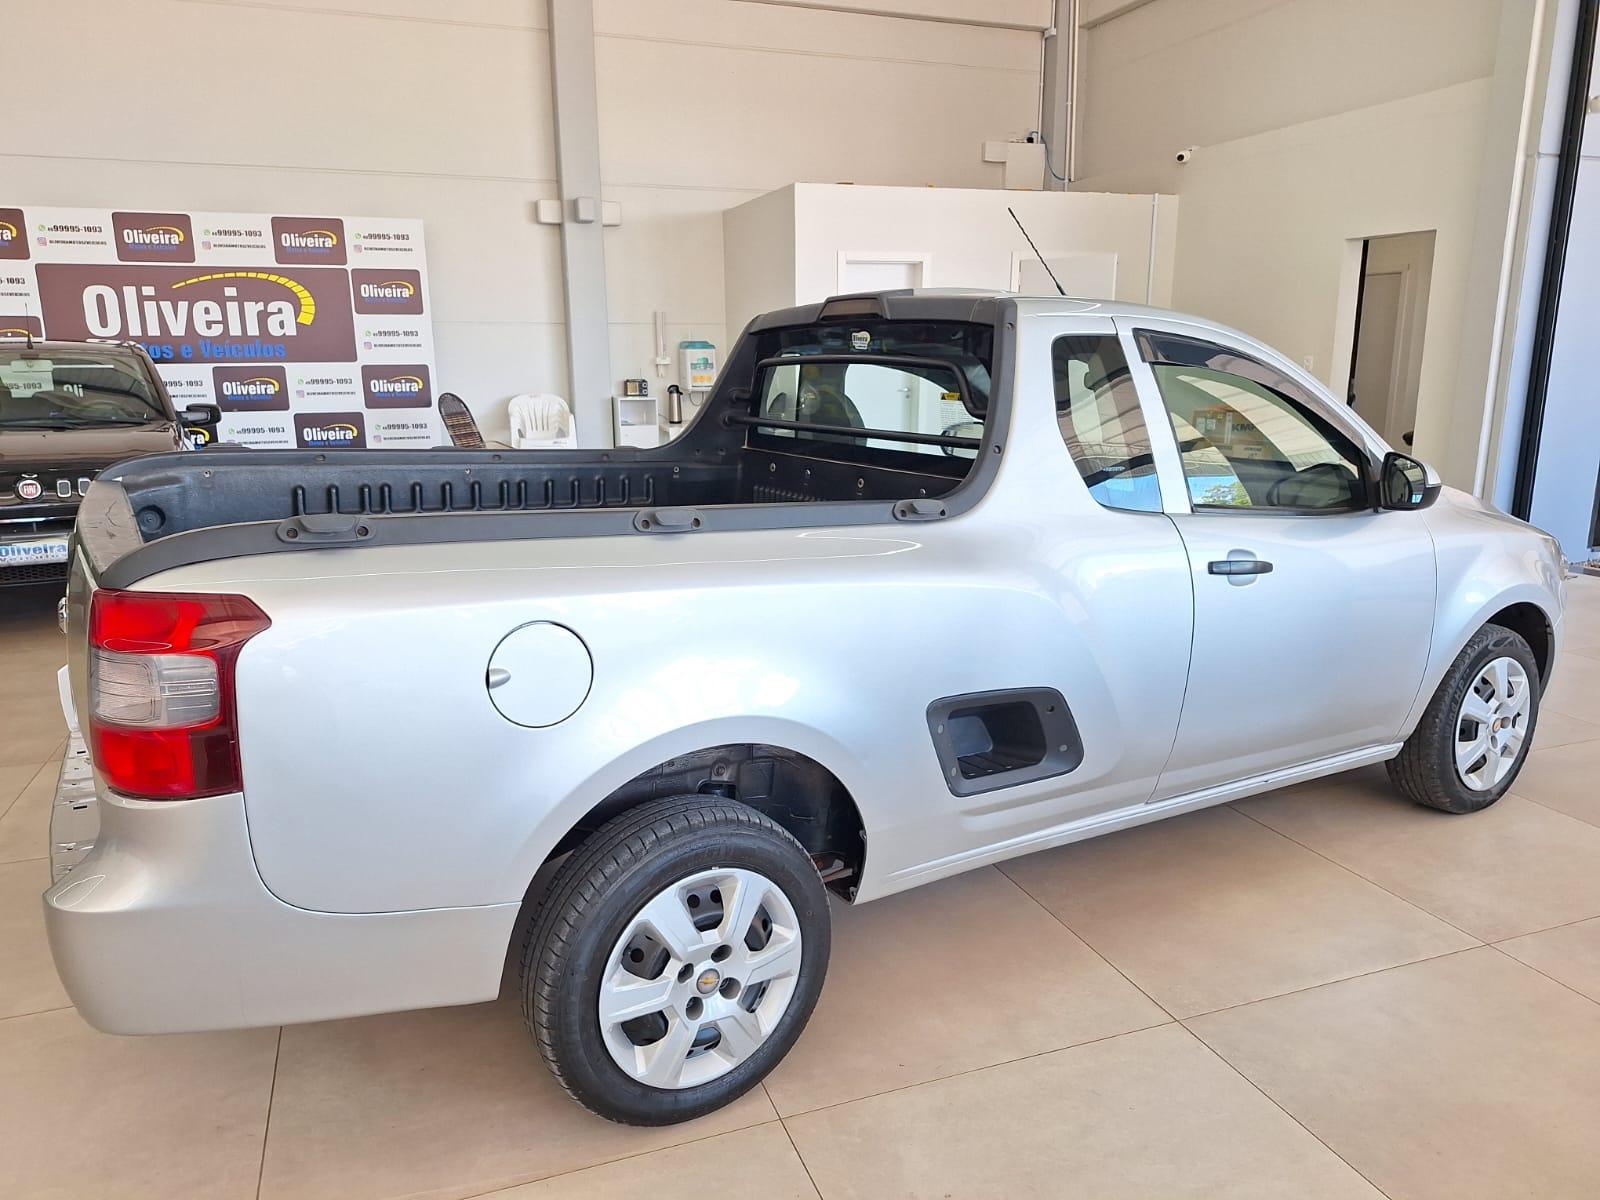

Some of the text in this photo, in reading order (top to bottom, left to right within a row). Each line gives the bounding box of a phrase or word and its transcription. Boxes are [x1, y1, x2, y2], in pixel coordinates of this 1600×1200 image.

[123, 229, 179, 245] Oliveira
[281, 233, 333, 247] Oliveira
[360, 284, 410, 298] Oliveira
[82, 284, 297, 337] Oliveira
[181, 344, 193, 358] e
[223, 381, 275, 395] Oliveira
[370, 379, 419, 393] Oliveira
[303, 427, 354, 441] Oliveira
[23, 484, 37, 495] FIAT
